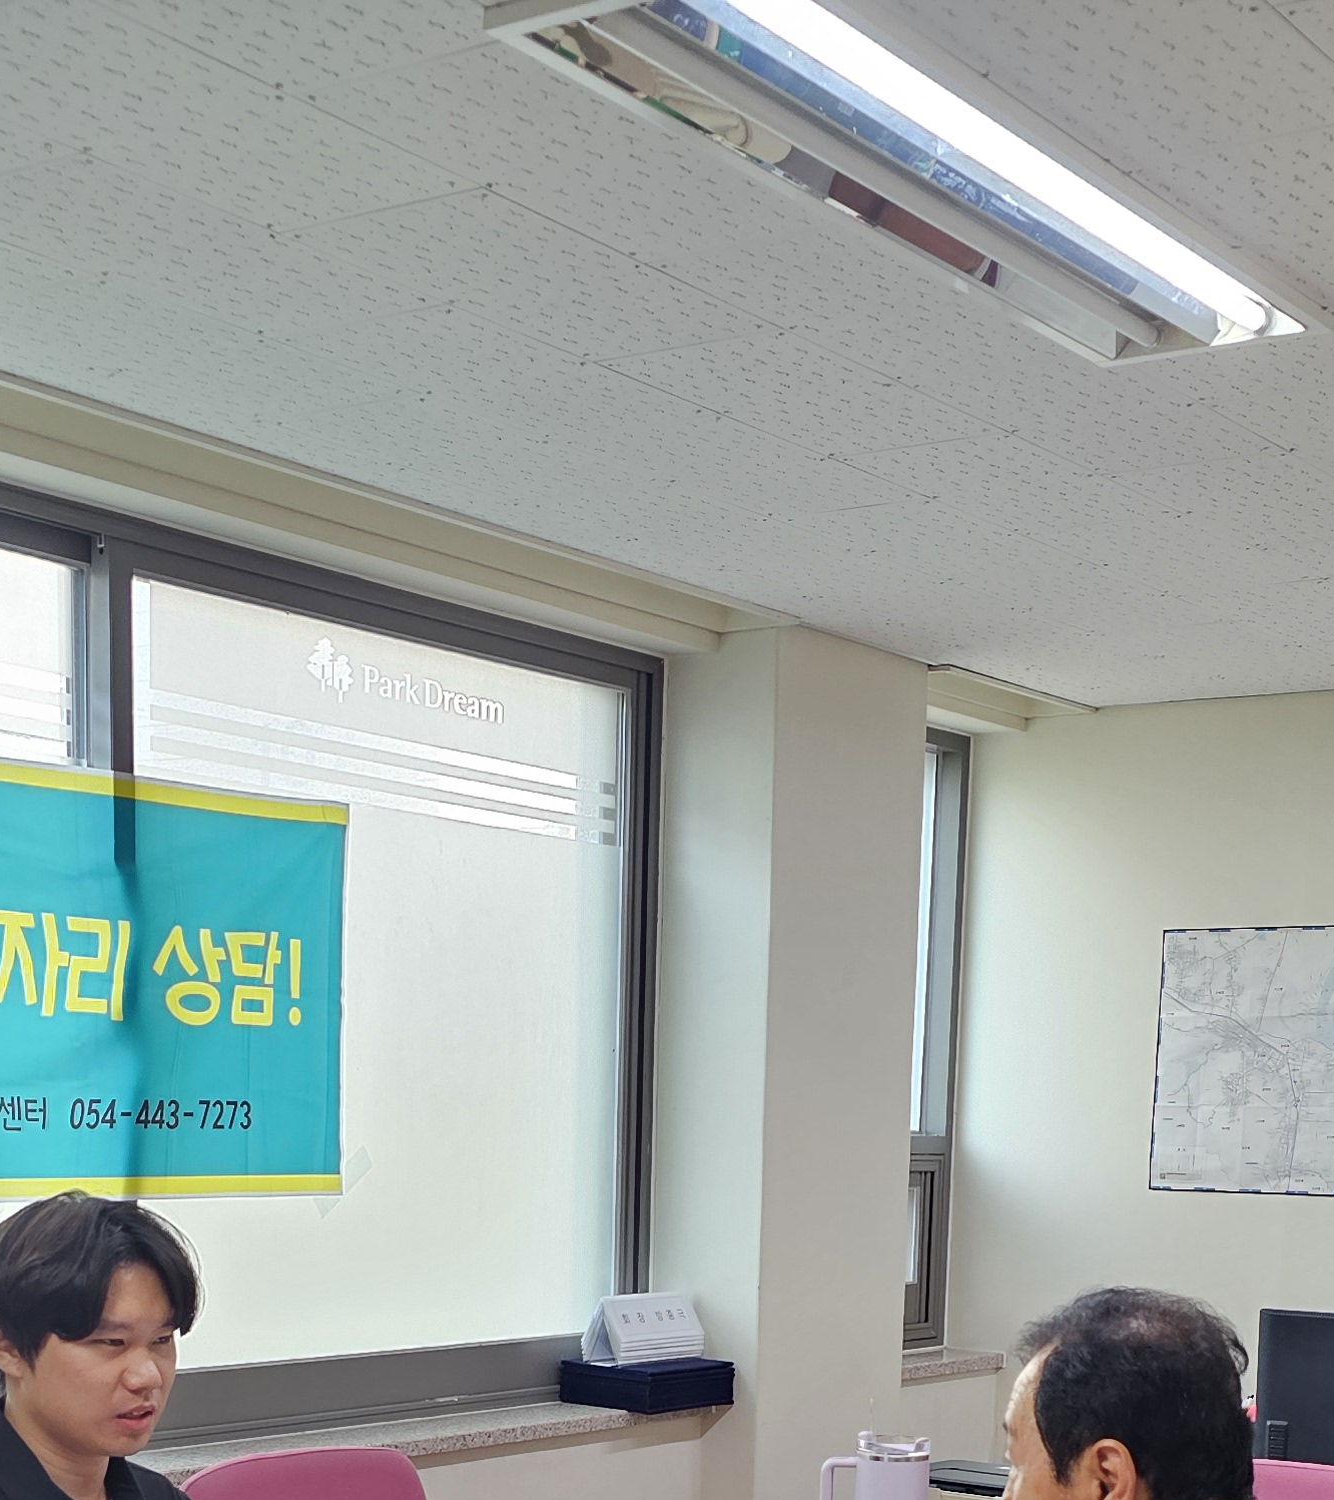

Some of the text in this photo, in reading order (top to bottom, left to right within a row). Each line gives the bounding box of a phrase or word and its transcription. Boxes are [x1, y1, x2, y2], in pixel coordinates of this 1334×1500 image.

[362, 664, 505, 724] Park Dream
[152, 924, 304, 1027] 상담!
[68, 1097, 253, 1132] 054-443-7273
